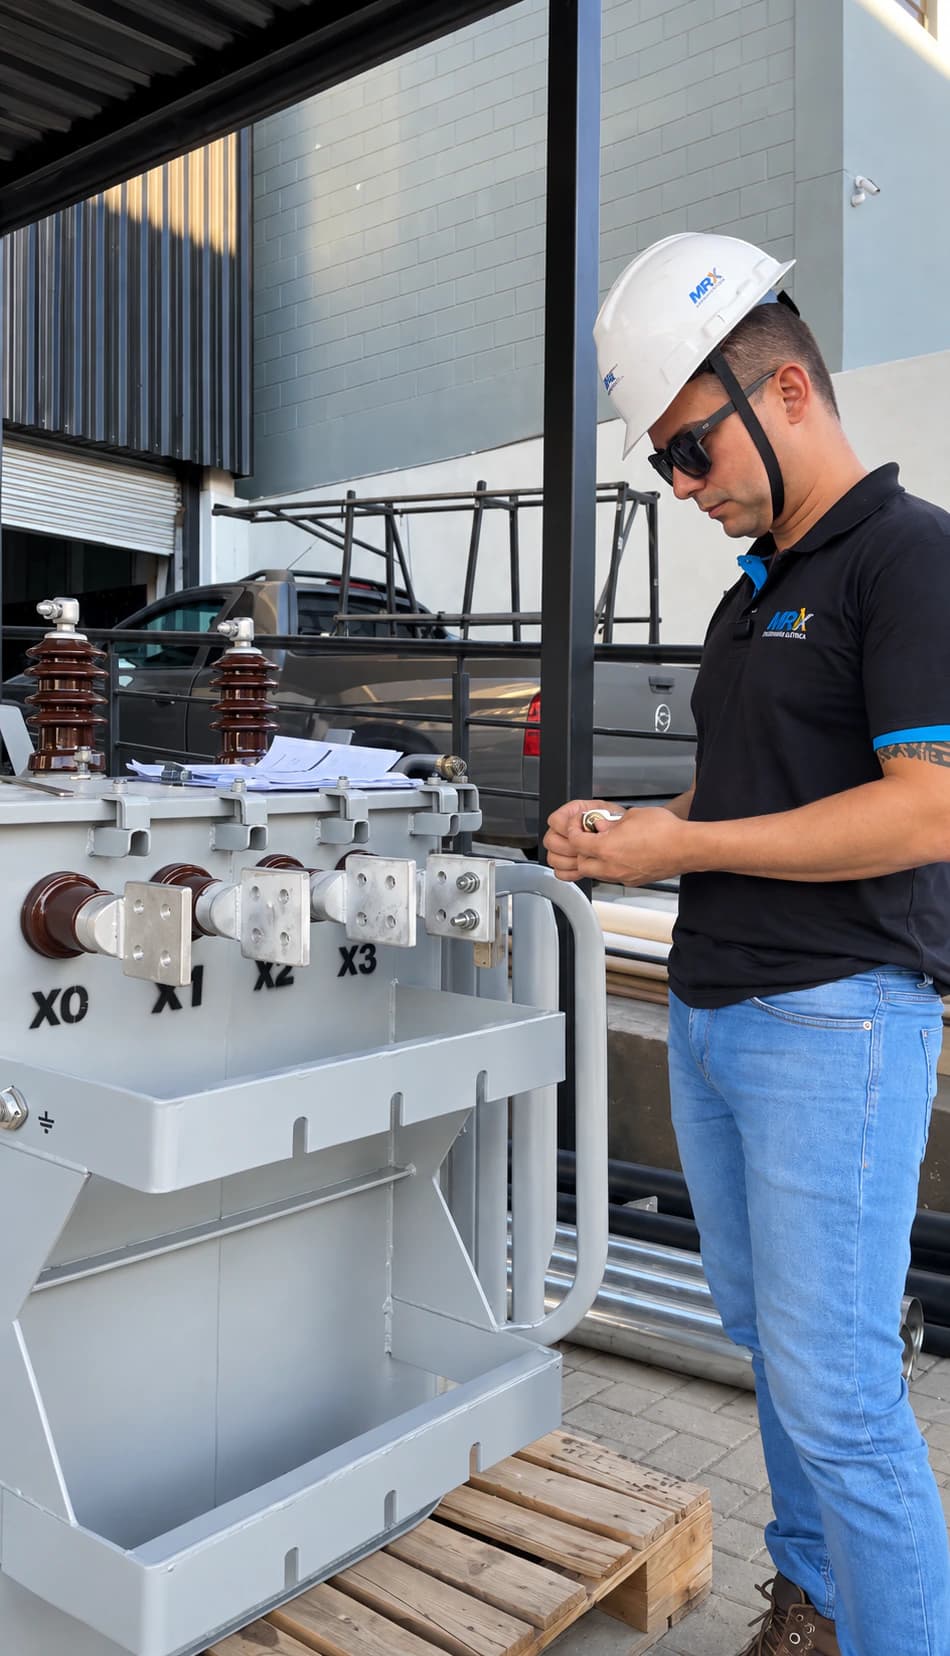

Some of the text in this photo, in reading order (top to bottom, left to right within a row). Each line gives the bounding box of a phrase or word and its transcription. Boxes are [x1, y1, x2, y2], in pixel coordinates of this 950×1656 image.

[689, 267, 722, 304] MRX
[767, 607, 814, 632] MRX
[253, 960, 295, 991] X2
[337, 943, 377, 977] X3
[29, 985, 89, 1029] X0
[151, 965, 204, 1014] X1
